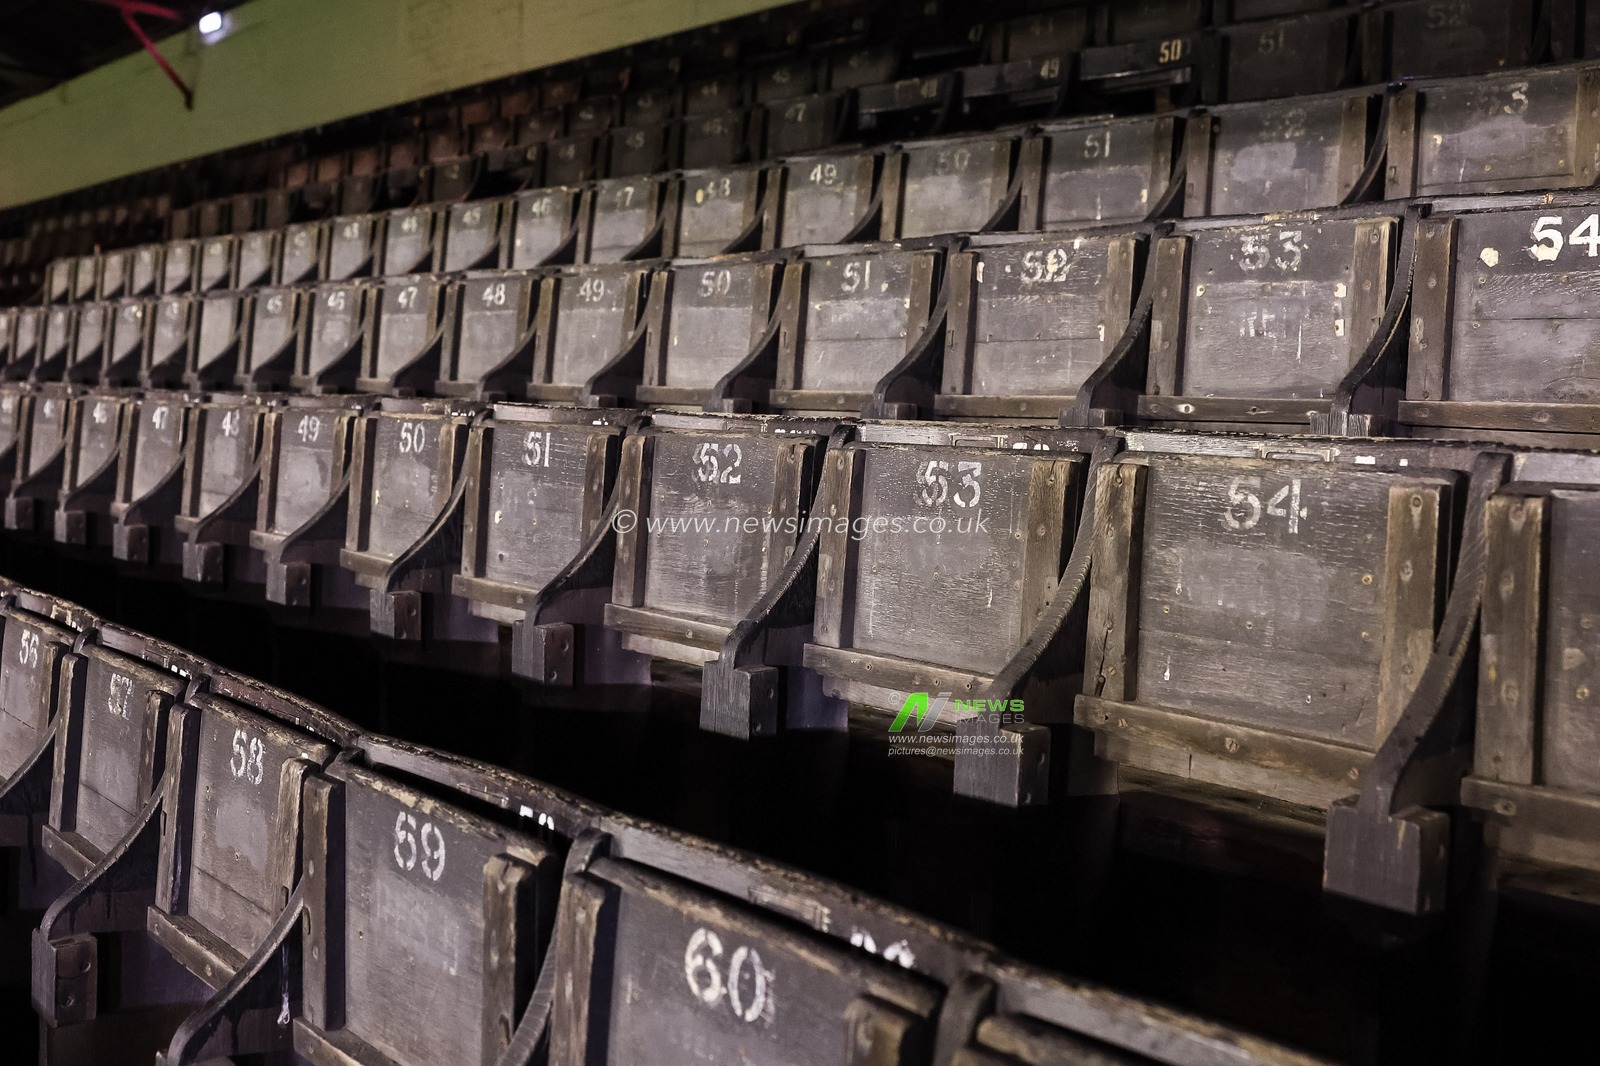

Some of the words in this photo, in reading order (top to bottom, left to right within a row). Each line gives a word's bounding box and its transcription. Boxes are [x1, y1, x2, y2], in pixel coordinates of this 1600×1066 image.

[1158, 38, 1182, 64] 50
[1039, 58, 1060, 80] 49
[1083, 130, 1111, 158] 51
[809, 163, 838, 184] 49
[1237, 229, 1303, 273] 53
[1529, 213, 1600, 261] 54
[578, 277, 606, 302] 49
[701, 269, 732, 297] 50
[841, 261, 871, 292] 51
[397, 285, 419, 309] 47
[481, 283, 506, 306] 48
[152, 405, 170, 430] 47
[221, 409, 241, 437] 48
[297, 414, 321, 443] 49
[399, 422, 426, 454] 50
[522, 431, 552, 468] 51
[693, 442, 743, 485] 52
[917, 460, 983, 508] 53
[1222, 476, 1309, 535] 54
[19, 628, 40, 669] 56
[229, 728, 266, 786] 58
[683, 926, 770, 1024] 60
